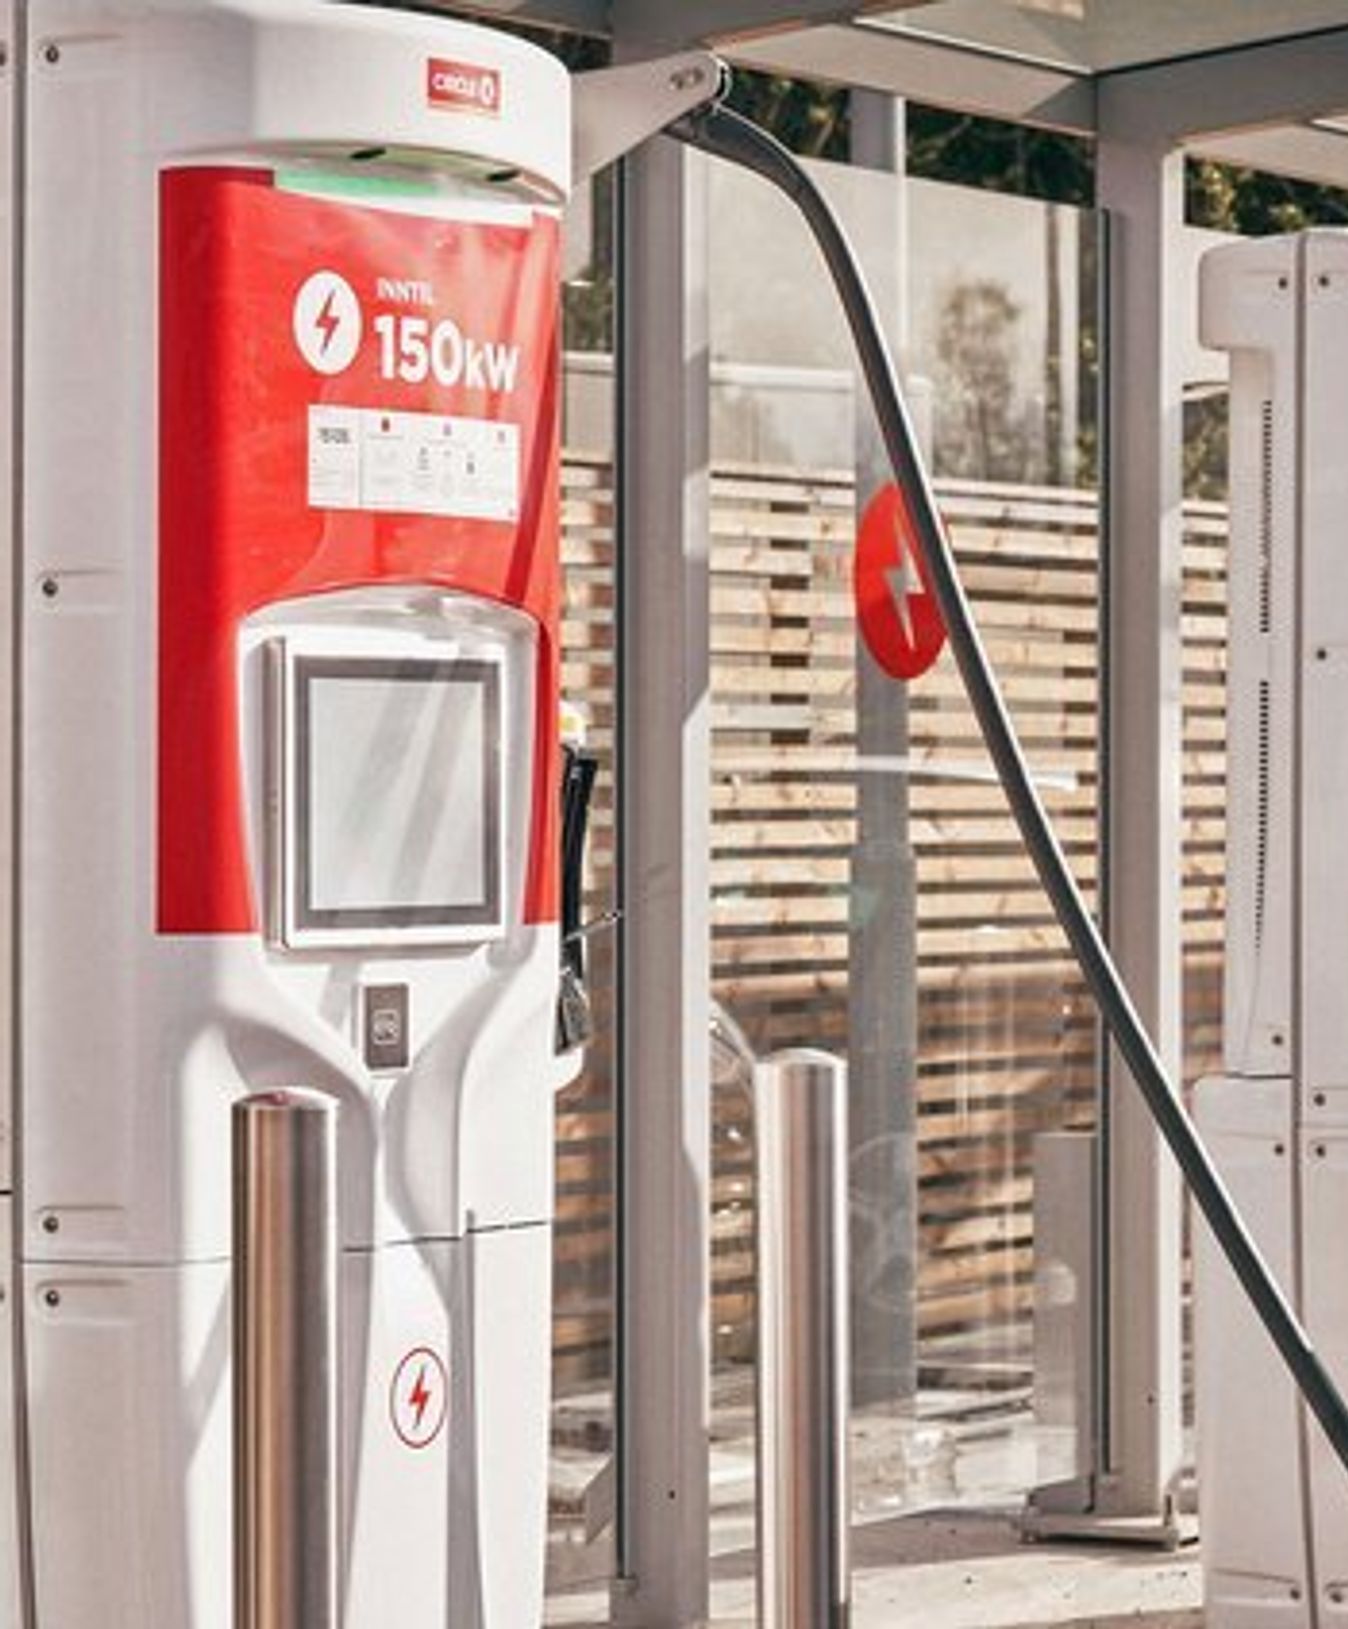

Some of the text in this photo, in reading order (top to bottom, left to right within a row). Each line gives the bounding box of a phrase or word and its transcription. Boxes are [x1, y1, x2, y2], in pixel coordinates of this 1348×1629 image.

[431, 73, 476, 98] CIRCLE
[376, 277, 435, 306] INNTIL
[373, 313, 519, 394] 150kW
